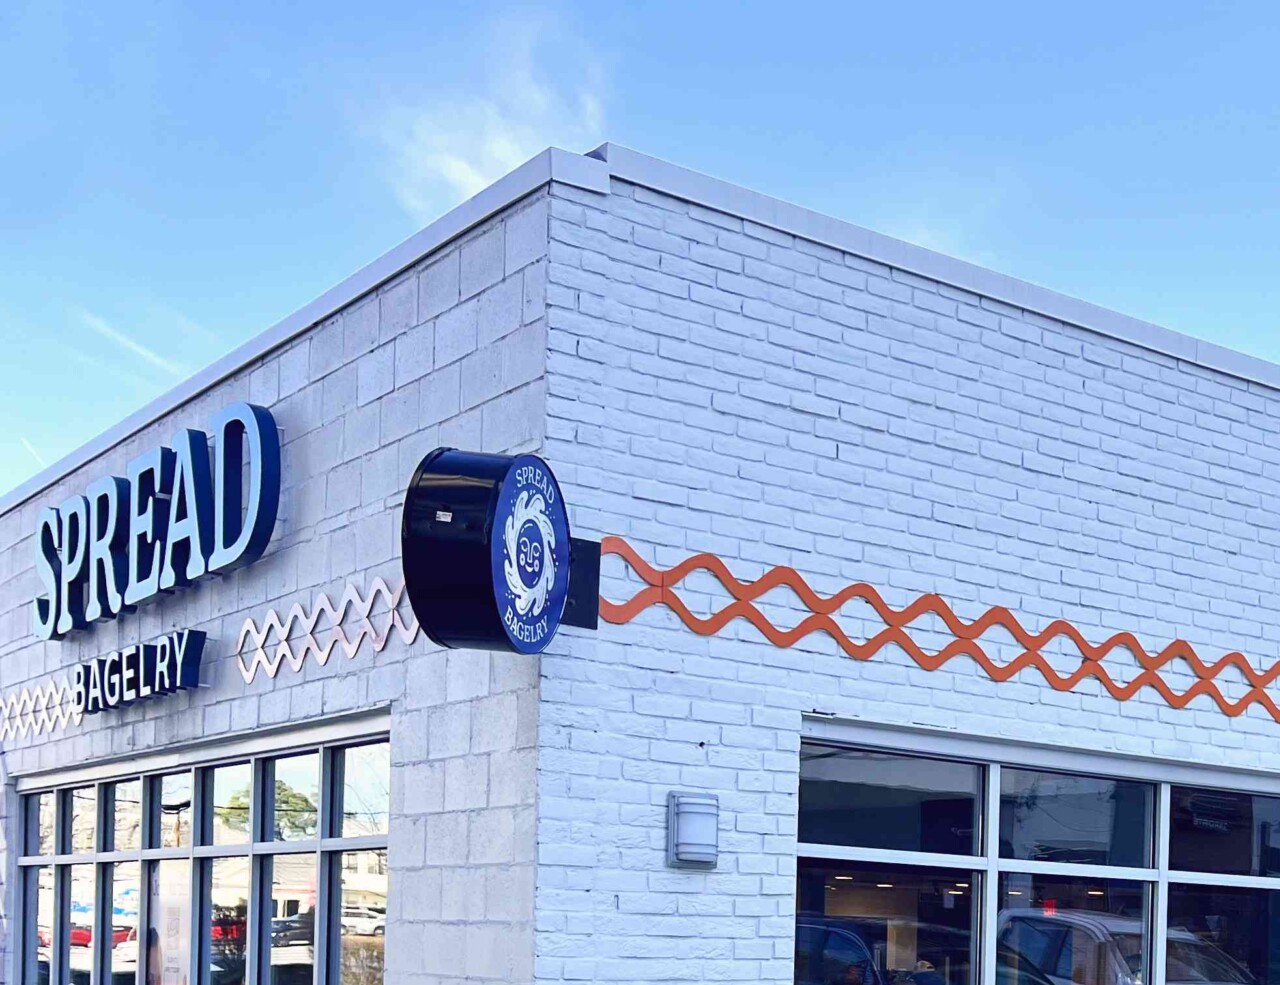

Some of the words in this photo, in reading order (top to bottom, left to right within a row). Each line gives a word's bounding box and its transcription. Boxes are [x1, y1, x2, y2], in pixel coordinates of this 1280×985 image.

[515, 465, 555, 504] SPREAD
[34, 402, 281, 641] SPREAD
[504, 604, 549, 643] BAGELRY
[71, 629, 200, 712] BAGELRY
